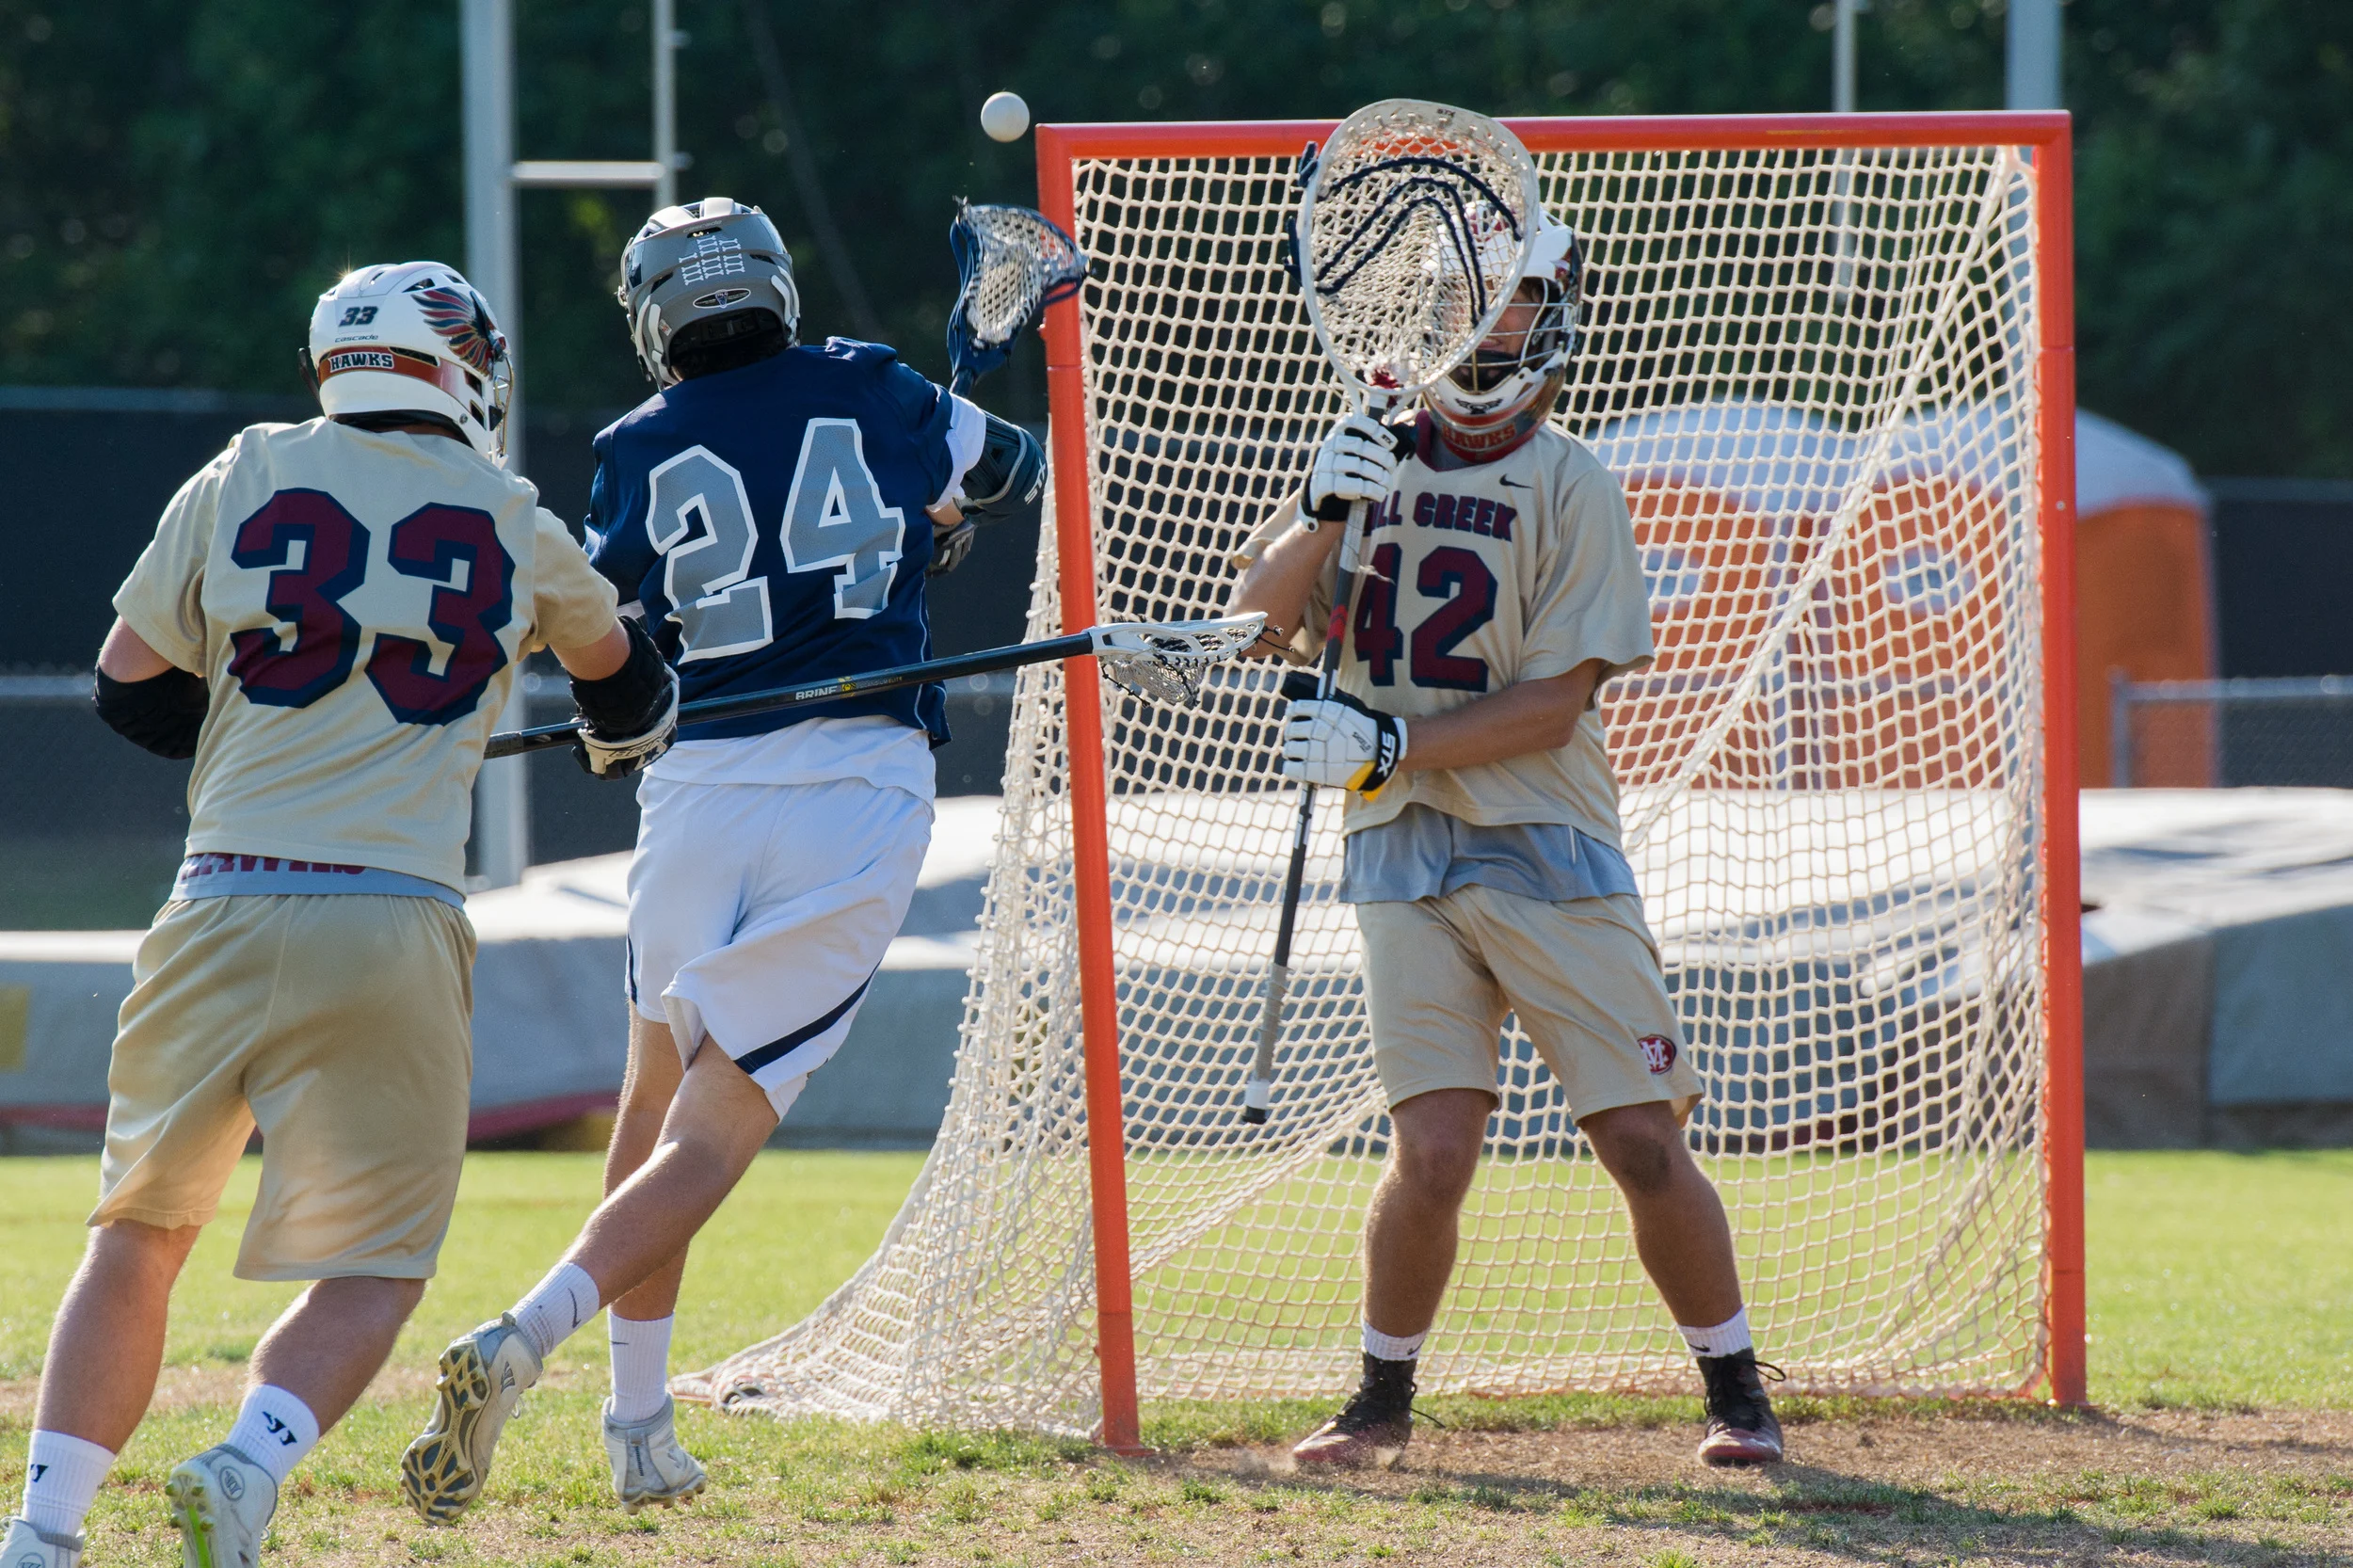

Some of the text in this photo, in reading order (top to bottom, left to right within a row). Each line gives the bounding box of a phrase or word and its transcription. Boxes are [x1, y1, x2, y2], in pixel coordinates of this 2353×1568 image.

[338, 306, 378, 327] 33
[328, 352, 394, 373] HAWKS
[1024, 457, 1047, 505] STX
[646, 417, 906, 665] 24
[227, 488, 517, 727] 33
[1353, 542, 1498, 693] 42
[1377, 730, 1397, 777] STX
